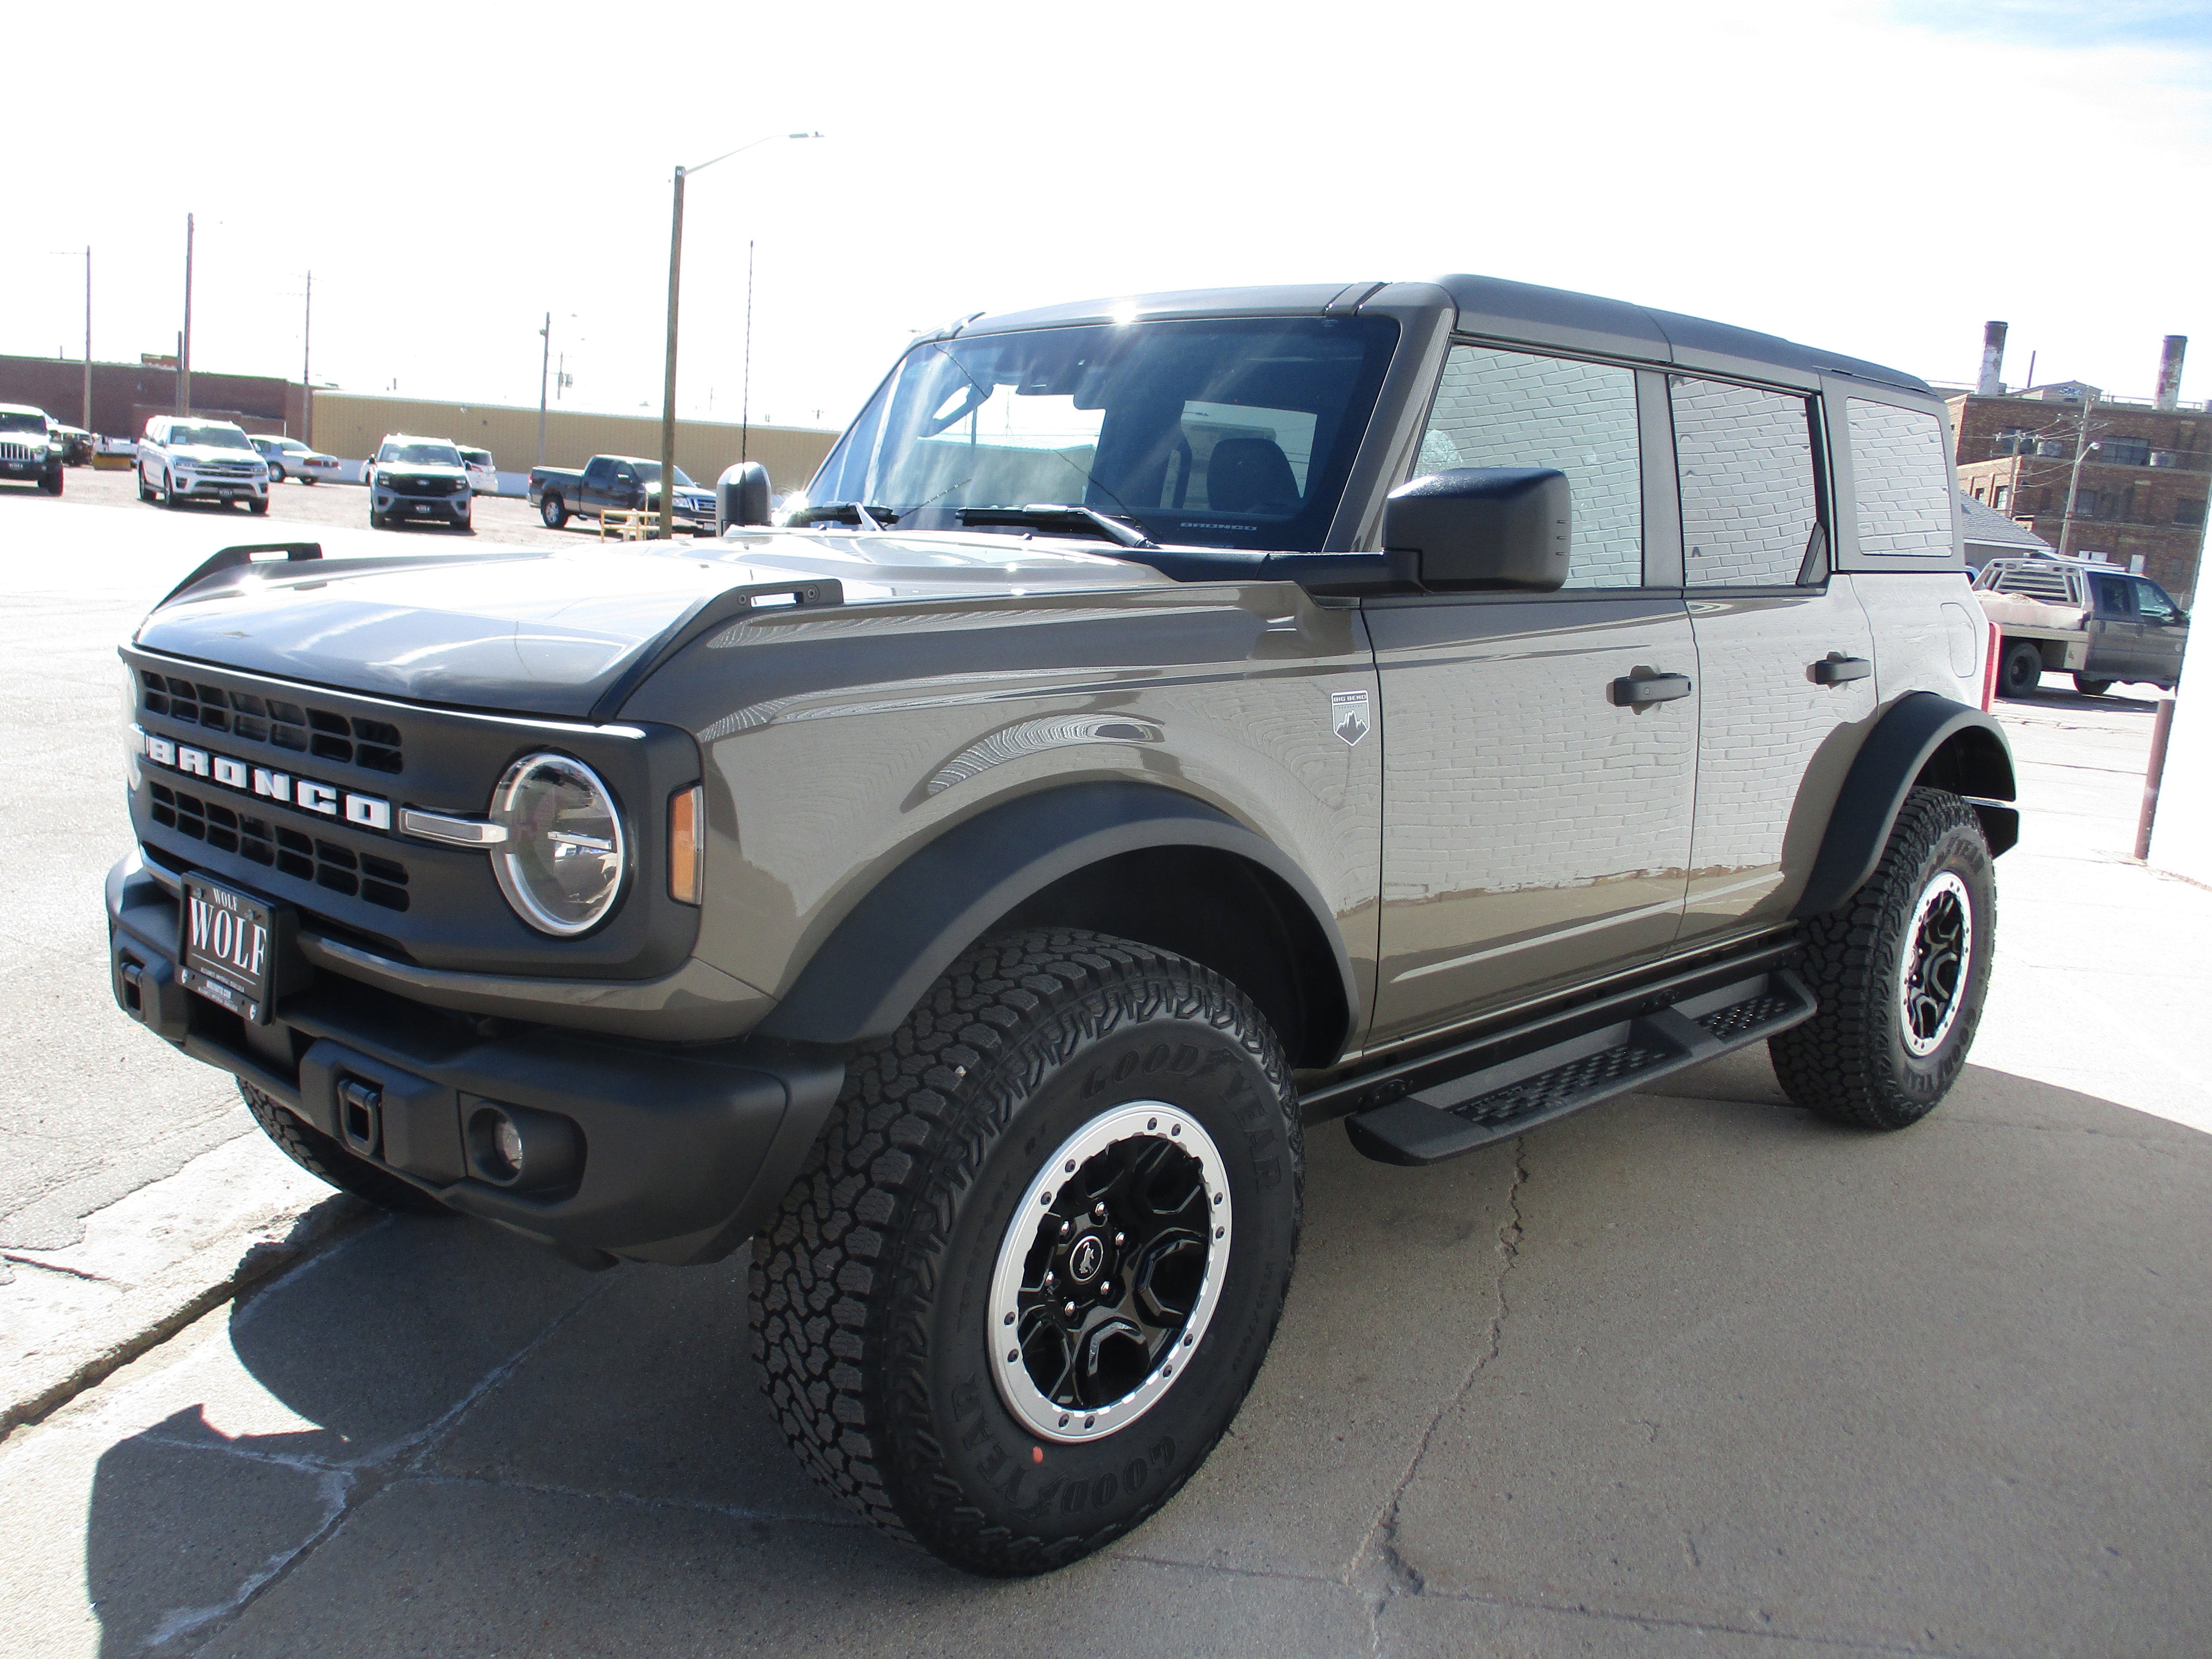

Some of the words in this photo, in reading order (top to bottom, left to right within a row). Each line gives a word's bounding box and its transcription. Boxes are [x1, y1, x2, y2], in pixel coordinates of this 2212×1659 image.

[1181, 522, 1257, 531] BRONCO
[149, 735, 390, 830] BRONCO
[213, 887, 238, 912] WOLF
[189, 896, 266, 975] WOLF
